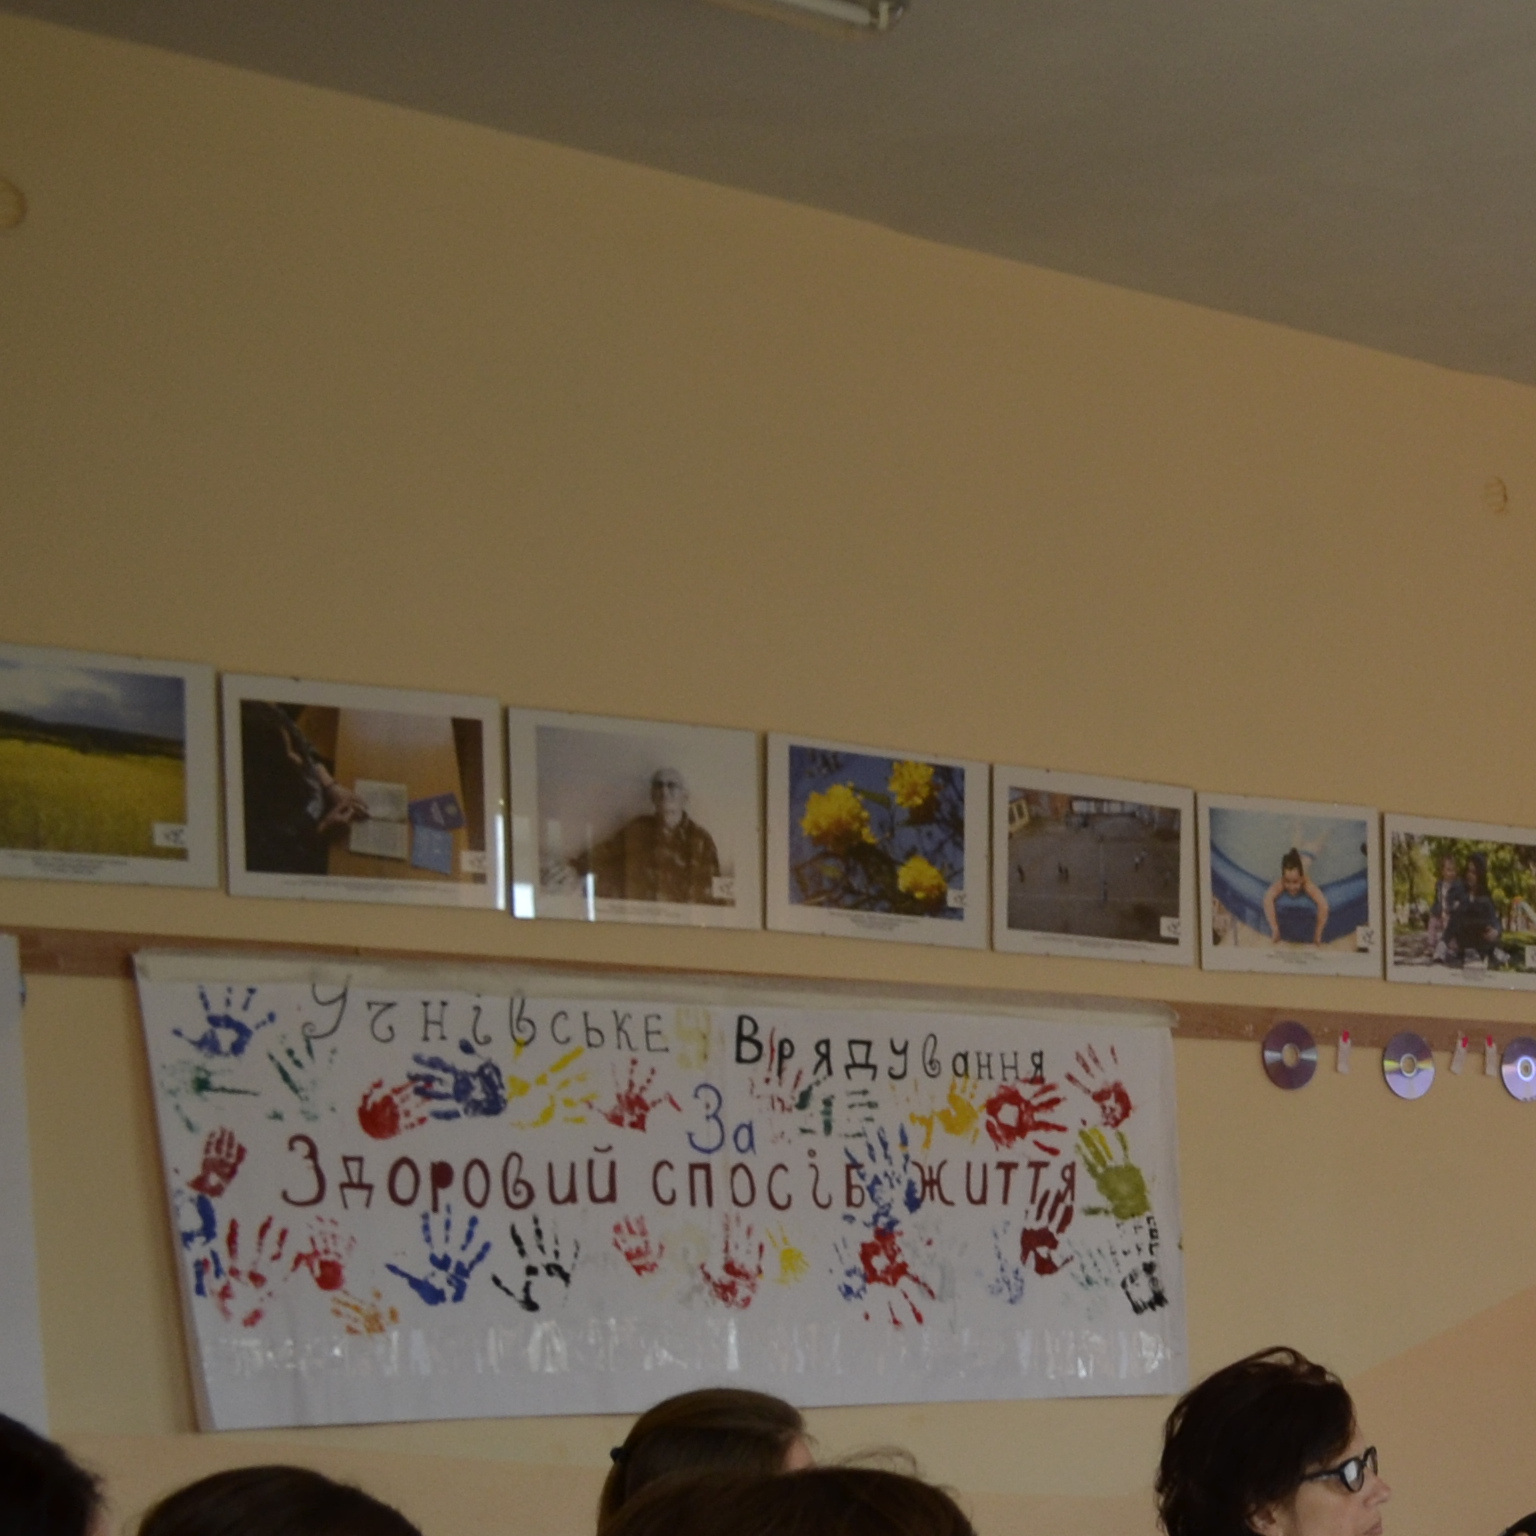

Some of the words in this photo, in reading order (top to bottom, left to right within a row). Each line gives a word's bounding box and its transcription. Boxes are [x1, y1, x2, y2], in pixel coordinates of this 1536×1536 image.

[734, 1013, 1046, 1083] Врядування
[688, 1083, 756, 1156] За
[282, 1134, 618, 1208] Здоровий
[652, 1147, 868, 1210] спосіб
[906, 1147, 1077, 1210] життя
